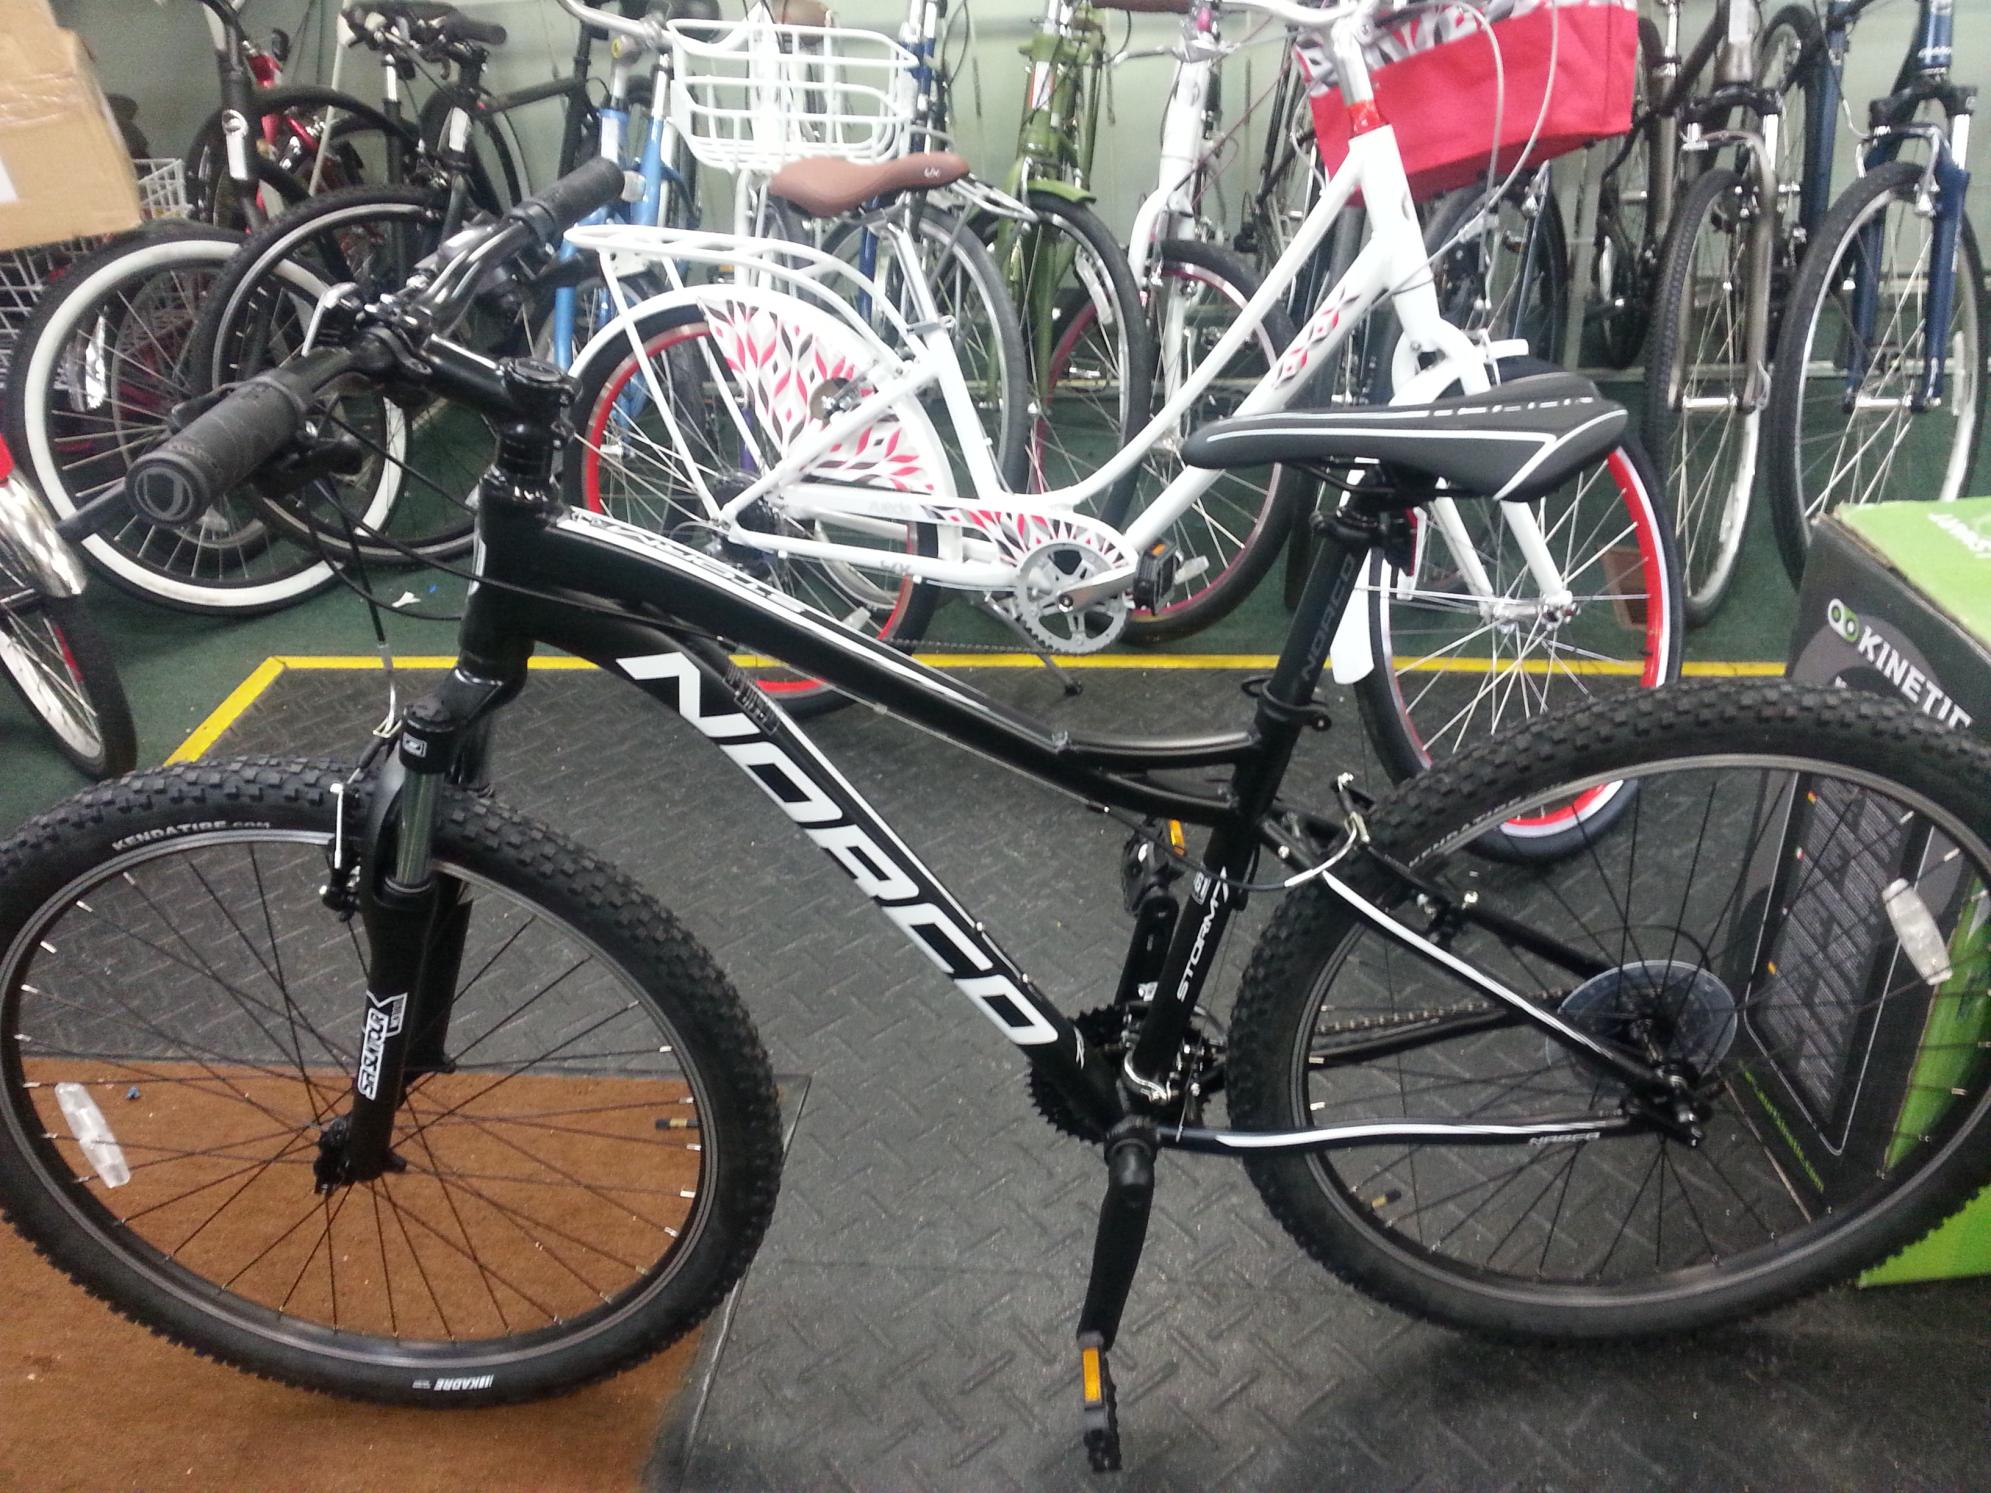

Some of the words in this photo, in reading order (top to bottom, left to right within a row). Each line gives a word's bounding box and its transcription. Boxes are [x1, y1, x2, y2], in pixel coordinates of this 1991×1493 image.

[1301, 552, 1355, 681] NORCO
[1857, 625, 1974, 729] KINETIC
[615, 651, 1059, 1046] NORCO
